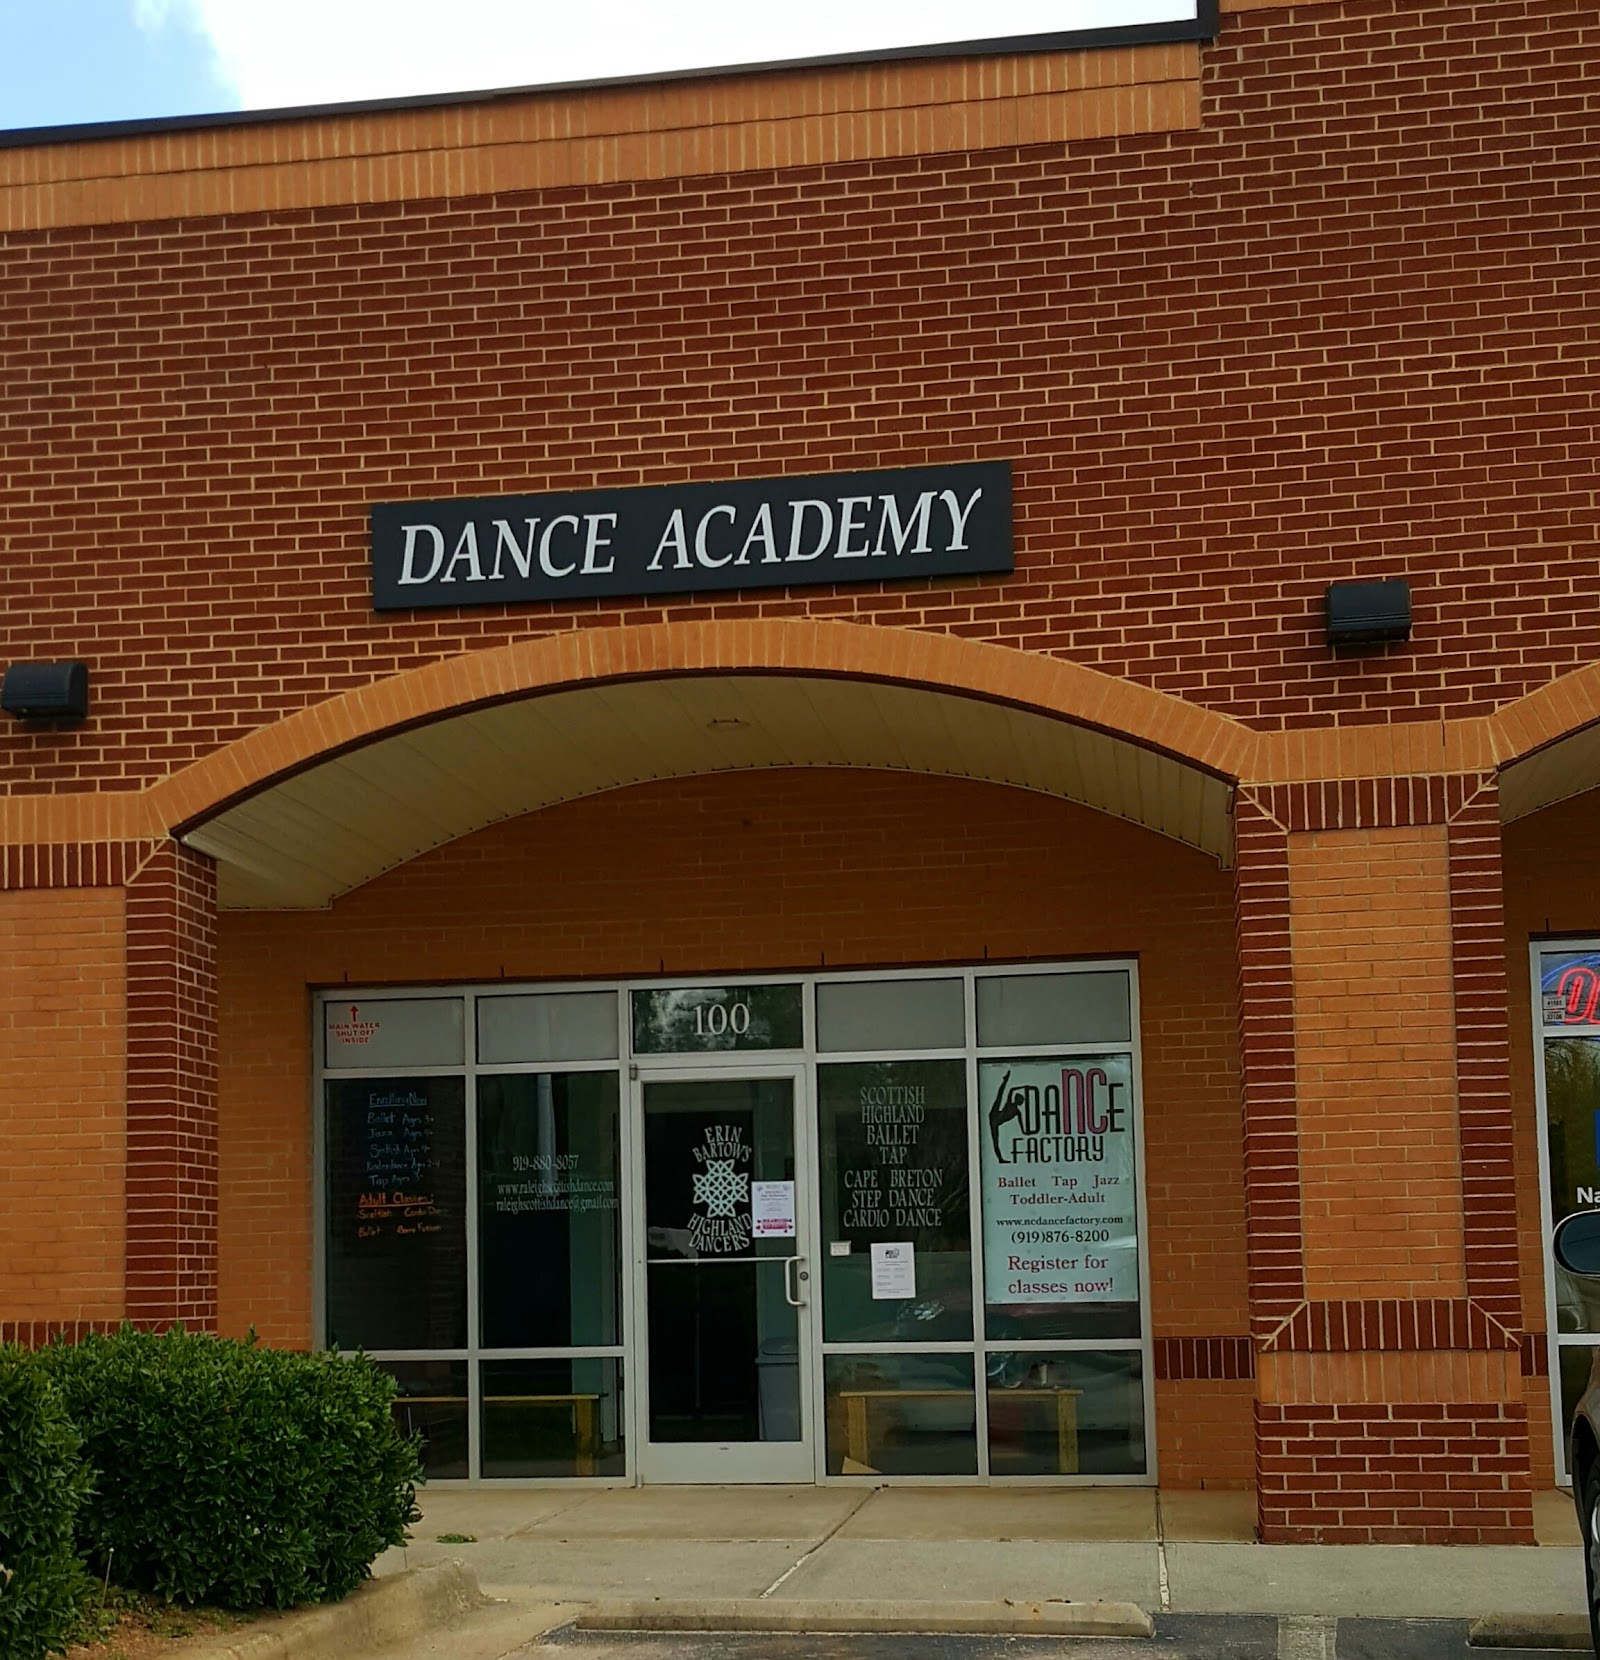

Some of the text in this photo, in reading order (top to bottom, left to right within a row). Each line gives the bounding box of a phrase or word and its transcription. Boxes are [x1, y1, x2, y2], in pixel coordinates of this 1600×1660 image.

[398, 488, 982, 586] DANCE ACADEMY
[695, 1003, 750, 1035] 100
[860, 1086, 925, 1105] SCOTTISH
[1024, 1068, 1125, 1135] DANCE
[367, 1112, 396, 1124] Ballet
[861, 1104, 925, 1124] HIGHLAND
[704, 1125, 743, 1143] ERIN
[866, 1124, 919, 1145] BALLET
[692, 1142, 752, 1162] BARTOW'S
[879, 1146, 908, 1165] TAP
[1010, 1136, 1104, 1164] FACTORY
[513, 1155, 579, 1171] 919-880-8057
[369, 1175, 388, 1189] Tap
[496, 1179, 614, 1197] www.raleighscottishdance.com
[844, 1168, 943, 1189] CAPE BRETON
[998, 1174, 1120, 1190] Ballet Tap Jazz
[358, 1192, 387, 1206] Adult
[851, 1188, 934, 1209] STEP DANCE
[1010, 1192, 1105, 1205] Toddler-Adult
[687, 1212, 752, 1237] HIGHLAND
[843, 1207, 942, 1228] CARDIO DANCE
[996, 1215, 1123, 1227] www.ncdancefactory.com
[688, 1231, 750, 1253] DANCERS
[1011, 1230, 1109, 1244] (919)876-8200
[1008, 1254, 1109, 1273] Register for
[1008, 1278, 1113, 1294] classes now!
